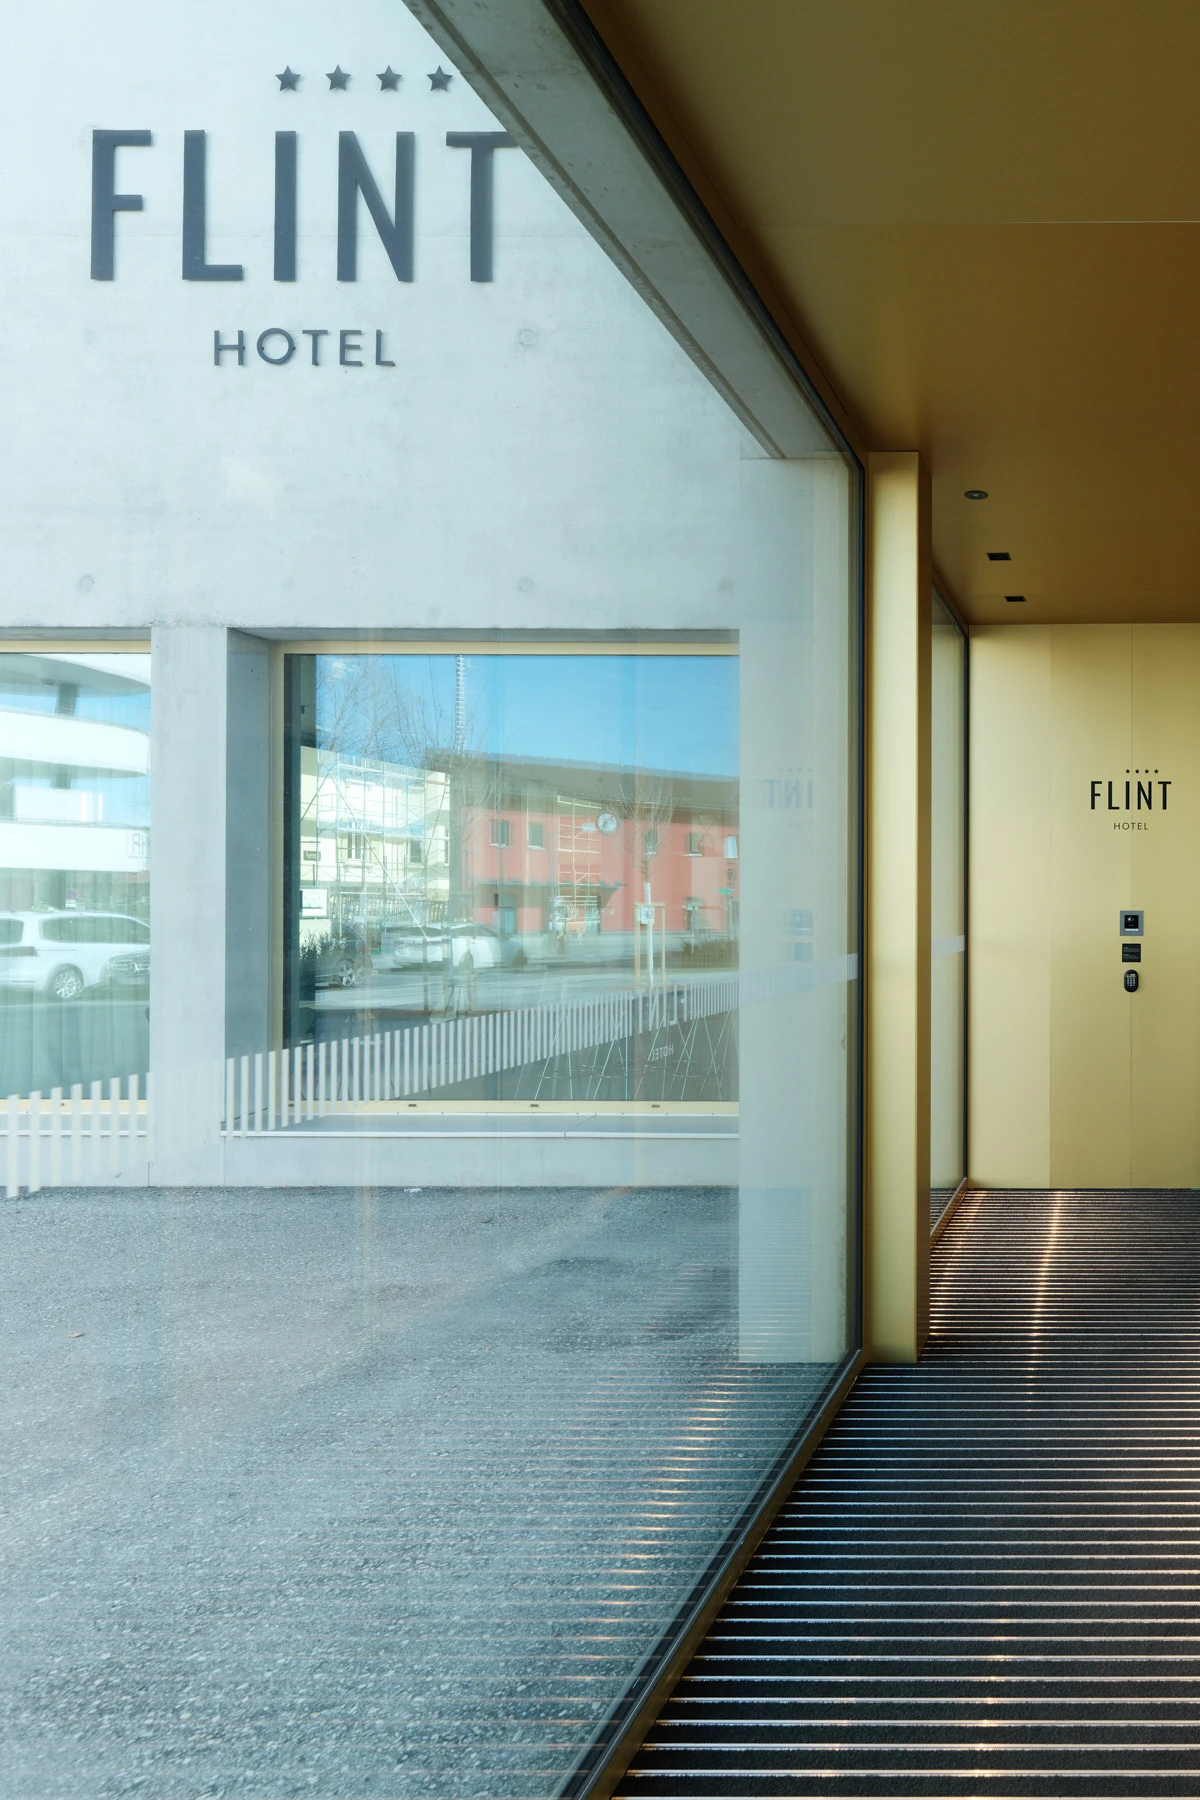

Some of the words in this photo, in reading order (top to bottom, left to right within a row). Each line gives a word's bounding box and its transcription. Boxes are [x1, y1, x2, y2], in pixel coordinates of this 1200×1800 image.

[90, 129, 518, 283] FLINT
[213, 327, 396, 367] HOTEL
[1089, 780, 1173, 811] FLINT
[1113, 822, 1149, 831] HOTEL
